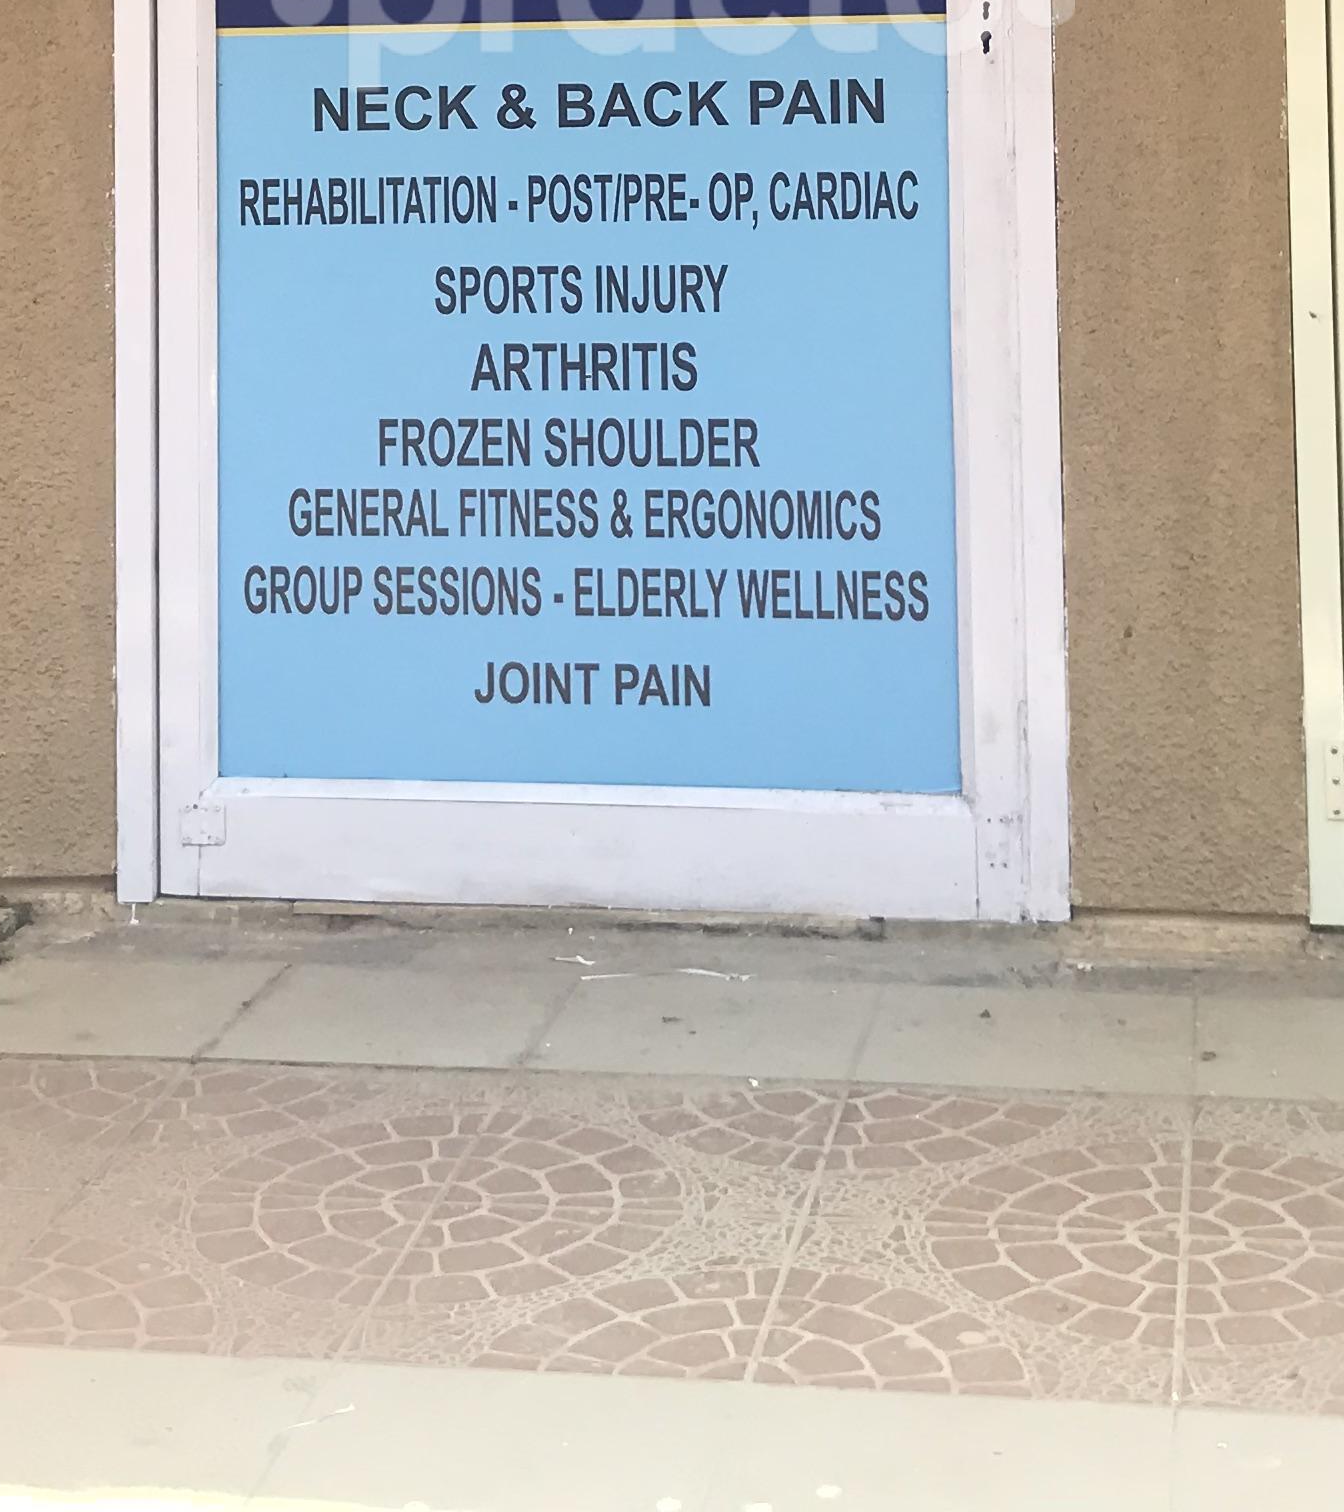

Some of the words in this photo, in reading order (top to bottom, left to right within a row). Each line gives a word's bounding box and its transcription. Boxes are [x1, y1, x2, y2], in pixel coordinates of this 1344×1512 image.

[313, 86, 477, 131] NECK
[497, 84, 536, 129] &
[558, 81, 728, 127] BACK
[750, 78, 885, 125] PAIN
[240, 175, 497, 226] REHABILITATION
[769, 171, 919, 220] CARDIAC
[434, 265, 582, 314] SPORTS
[596, 264, 728, 313] INJURY
[471, 342, 698, 391] ARTHRITIS
[378, 418, 531, 466] FROZEN
[544, 418, 760, 467] SHOULDER
[289, 489, 449, 537] GENERAL
[460, 489, 599, 538] FITNESS
[612, 490, 633, 538] &
[645, 490, 880, 540] ERGONOMICS
[244, 565, 362, 614] GROUP
[373, 567, 542, 616] SESSIONS
[575, 568, 728, 618] ELDERLY
[738, 569, 930, 622] WELLNESS
[475, 662, 599, 705] JOINT
[615, 663, 711, 707] PAIN
